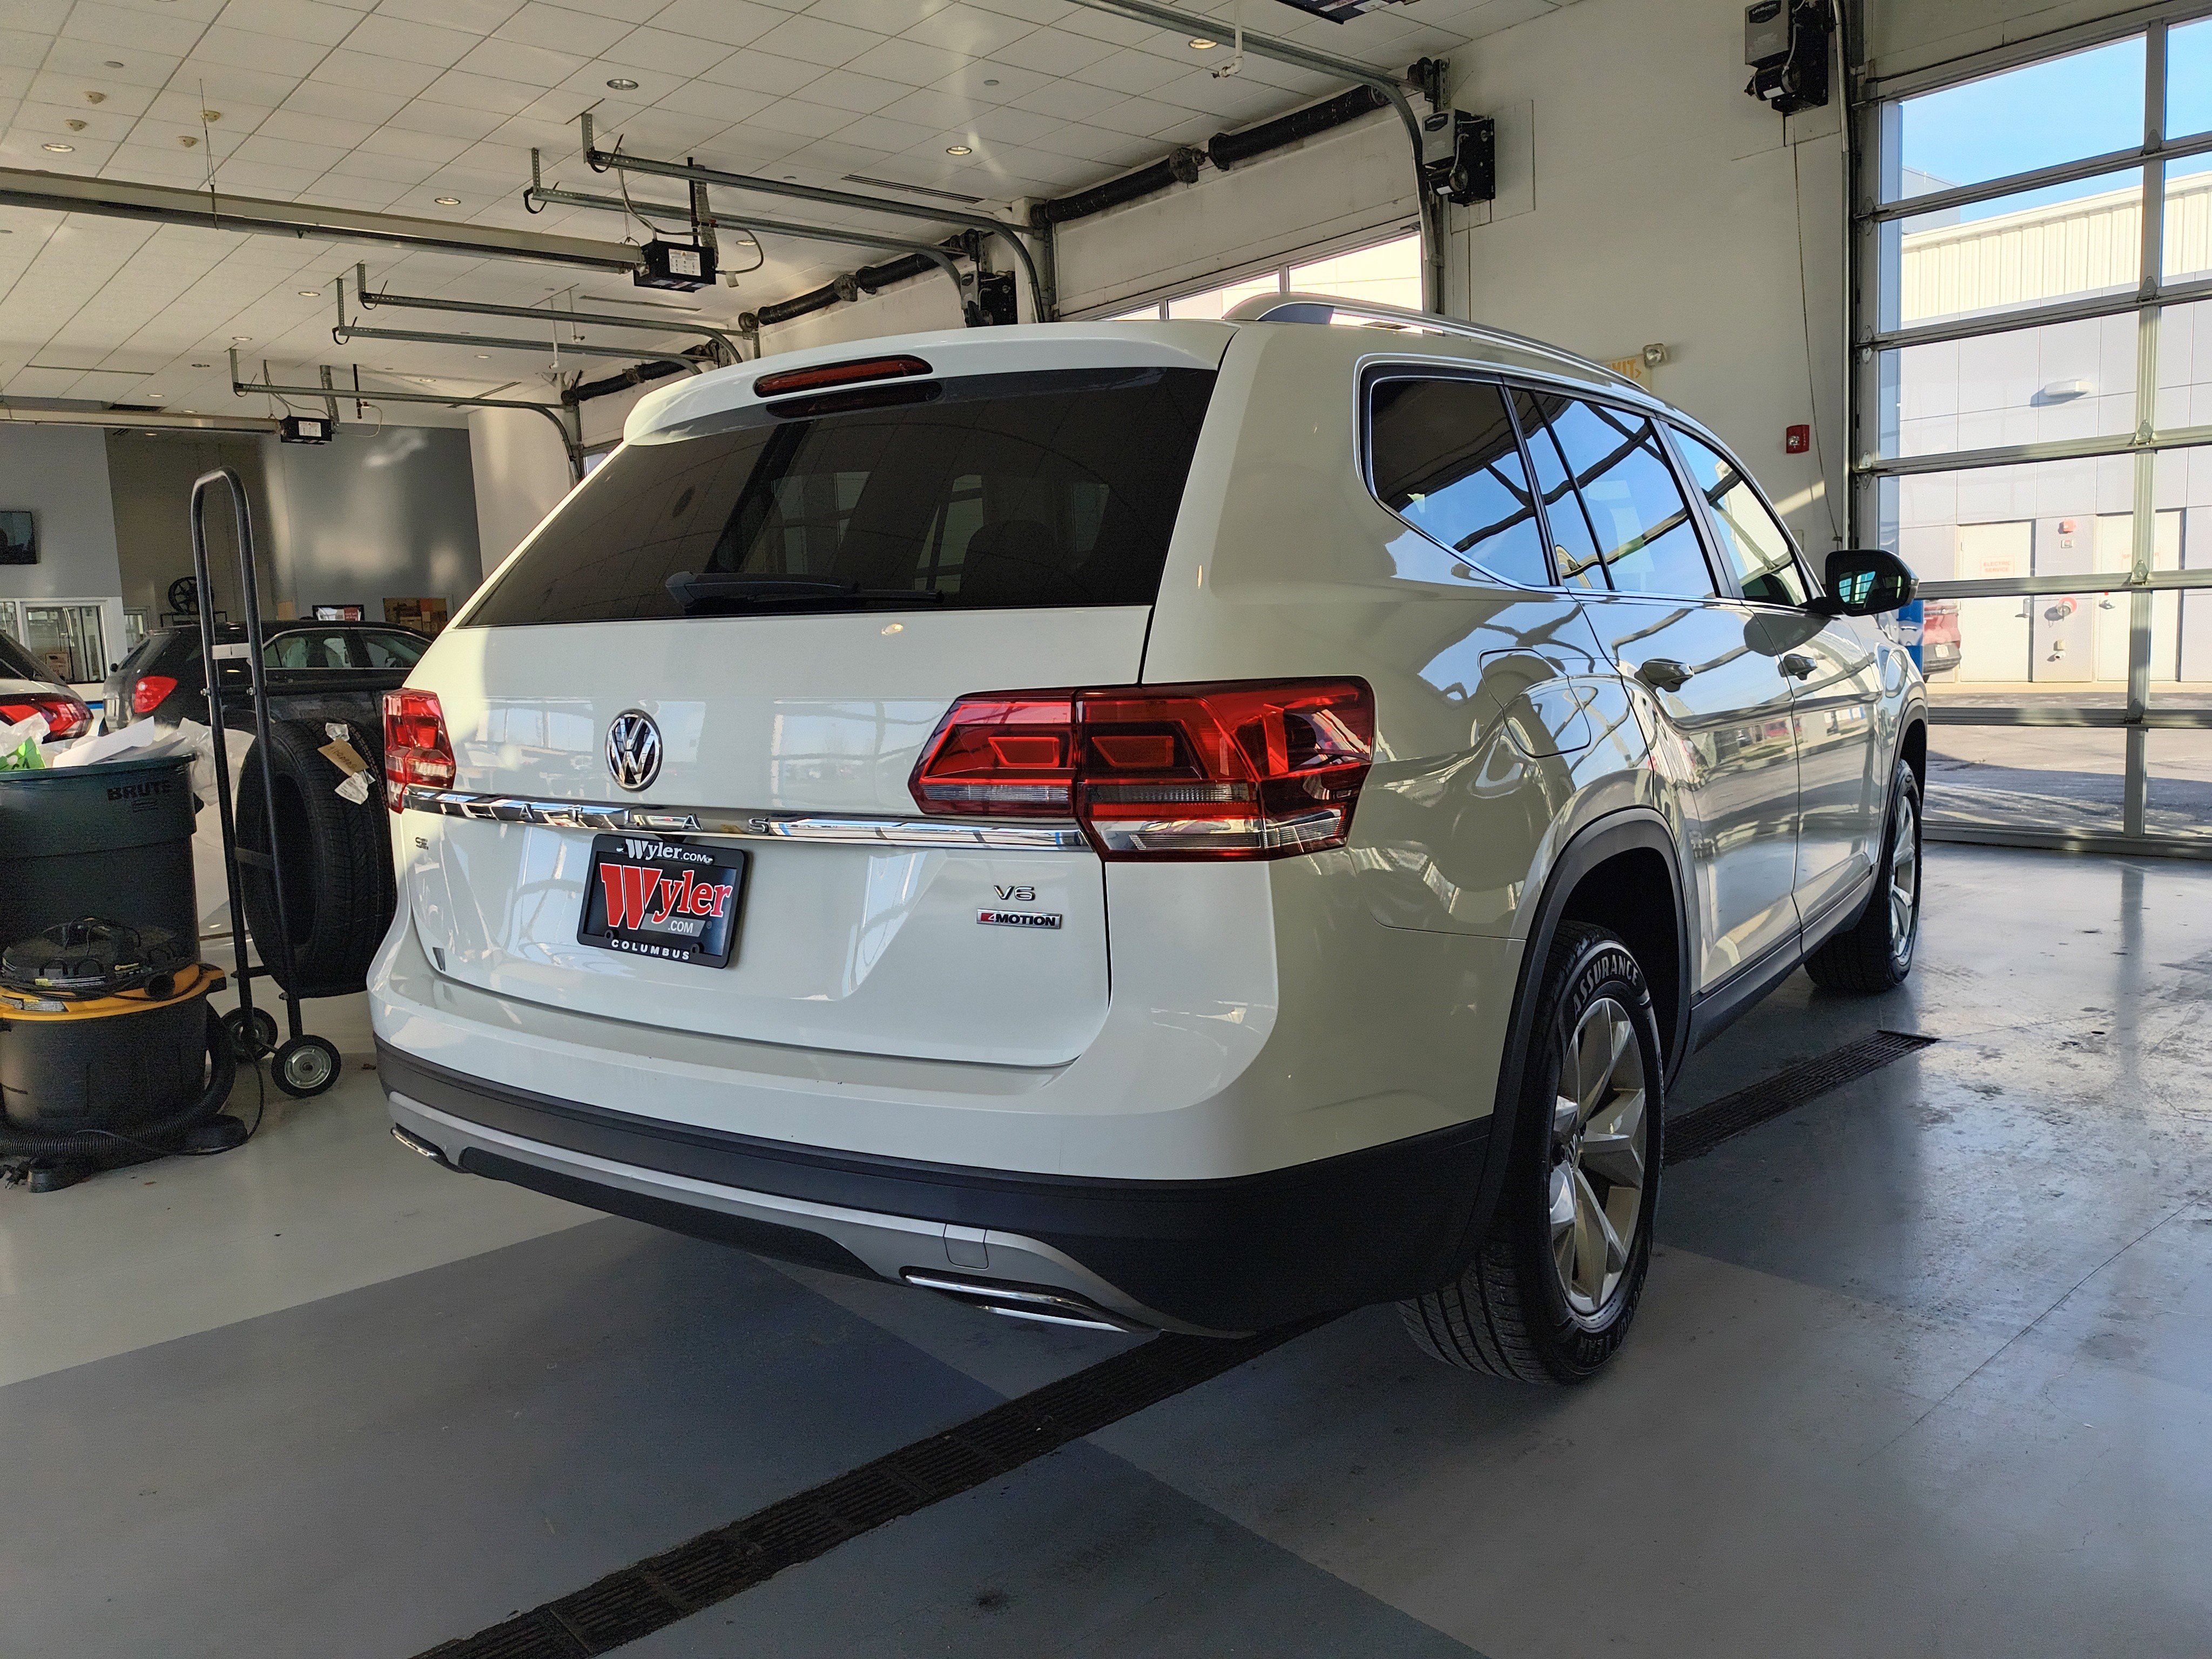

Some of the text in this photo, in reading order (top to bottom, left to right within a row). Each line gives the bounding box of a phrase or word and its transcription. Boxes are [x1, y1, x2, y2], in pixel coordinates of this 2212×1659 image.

[1607, 359, 1636, 378] XIT
[107, 780, 173, 801] BRUTE
[415, 837, 429, 850] SE
[599, 862, 733, 930] Wyler
[994, 885, 1036, 901] V6
[984, 912, 1056, 926] 4MOTION
[611, 939, 690, 960] COLUMBUS
[1573, 954, 1639, 1021] ASSURANCE
[1576, 1274, 1645, 1362] YEAR
